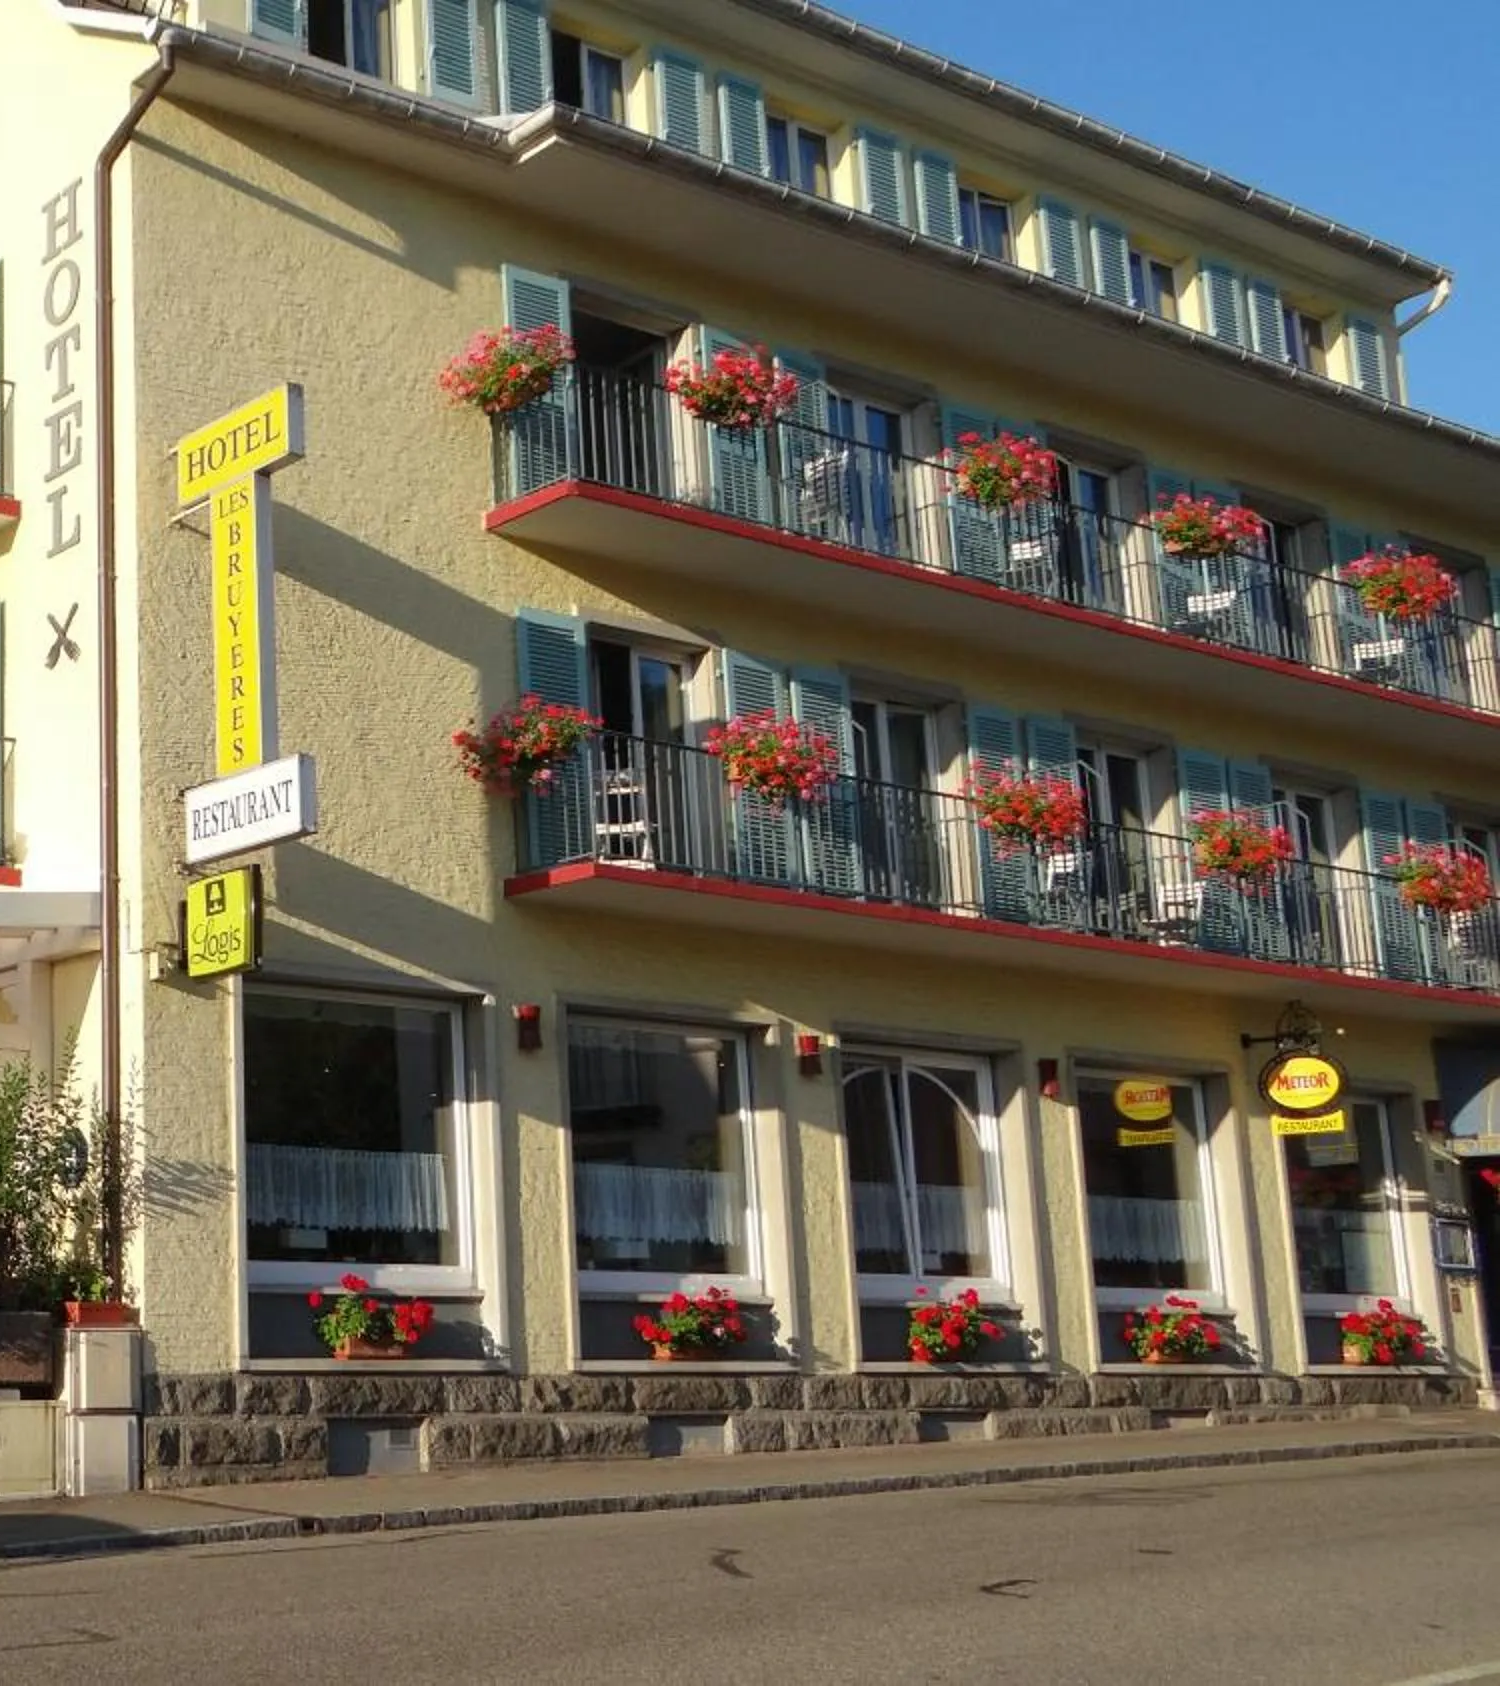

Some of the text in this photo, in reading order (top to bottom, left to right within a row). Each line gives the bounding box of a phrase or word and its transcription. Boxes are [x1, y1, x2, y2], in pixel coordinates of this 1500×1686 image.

[41, 177, 83, 559] HOTEL
[187, 410, 281, 482] HOTEL
[218, 487, 249, 518] LES
[227, 521, 245, 763] BRUYERES
[192, 779, 293, 841] RESTAURANT
[190, 918, 241, 964] Logis
[1275, 1072, 1331, 1090] METEOR
[1277, 1119, 1338, 1132] RESTAURANT
